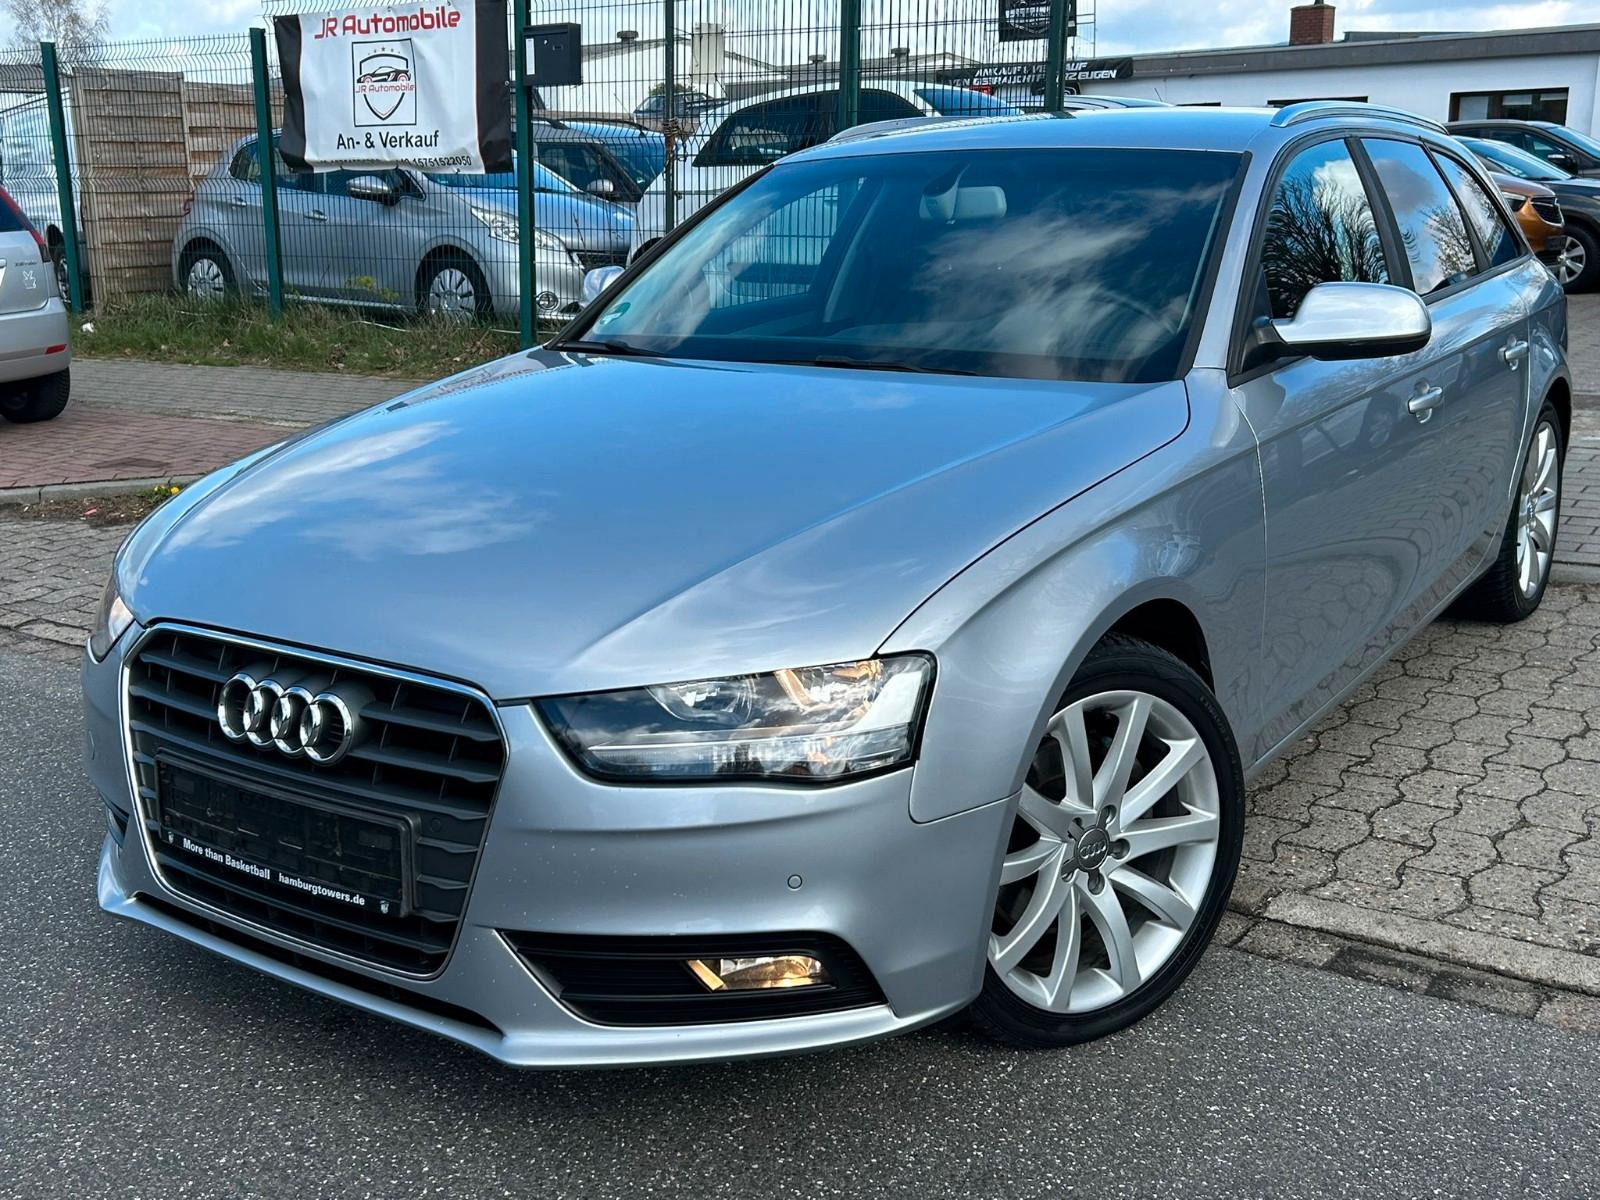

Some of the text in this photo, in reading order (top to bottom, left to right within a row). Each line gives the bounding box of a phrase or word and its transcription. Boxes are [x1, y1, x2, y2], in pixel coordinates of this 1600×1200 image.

[314, 5, 461, 39] JR Automobile
[355, 82, 415, 93] JR Automobile
[336, 130, 440, 150] An- & Verkauf
[183, 837, 366, 906] More than Basketball hamburgtowers.de
